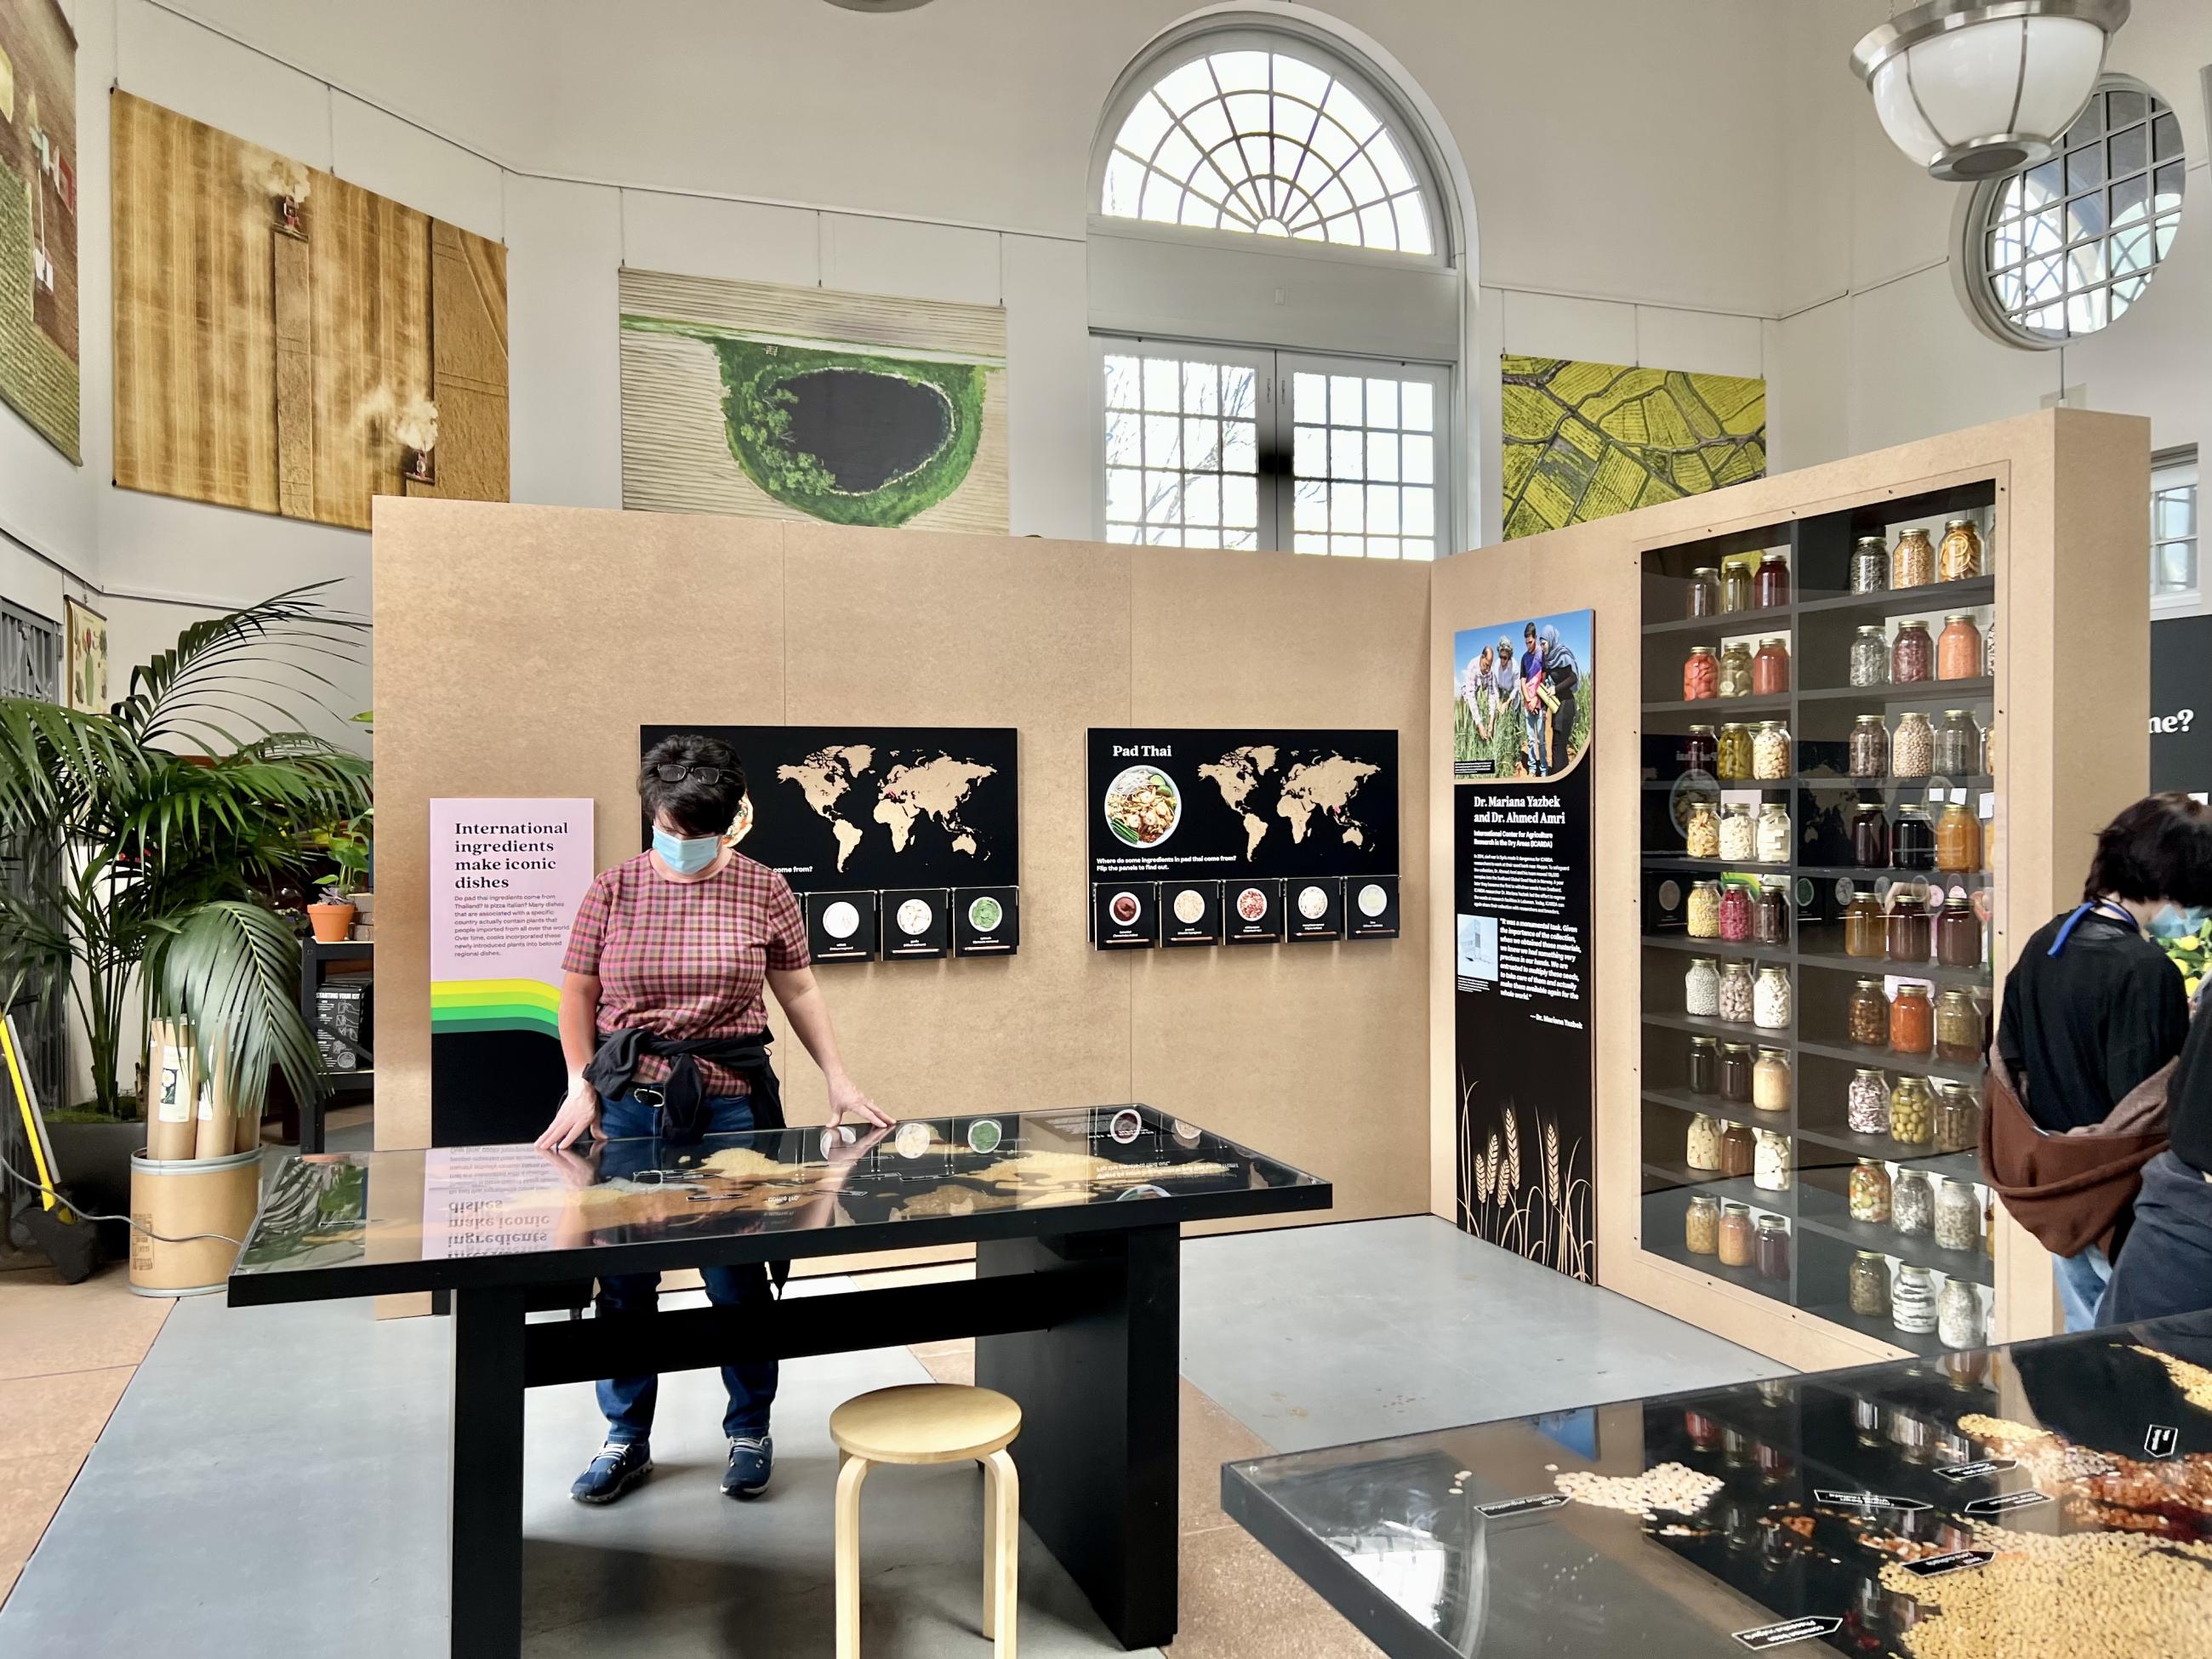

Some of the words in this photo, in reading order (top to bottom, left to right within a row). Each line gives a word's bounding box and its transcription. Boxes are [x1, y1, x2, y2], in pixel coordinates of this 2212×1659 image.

[1113, 745, 1138, 757] Pad
[1141, 745, 1172, 756] Thai
[1474, 796, 1487, 807] Dr.
[1489, 796, 1526, 807] Mariana
[1527, 795, 1560, 807] Yazbek
[1474, 811, 1490, 822] and
[1491, 812, 1505, 823] Dr.
[1506, 812, 1539, 823] Ahmed
[1540, 812, 1565, 824] Amri
[455, 823, 568, 834] International
[455, 840, 554, 855] ingredients
[455, 859, 501, 870] make
[506, 858, 556, 869] iconic
[455, 877, 509, 888] dishes
[1508, 927, 1535, 937] importance
[1550, 933, 1576, 943] collection,
[1521, 939, 1542, 947] obtained
[1557, 944, 1581, 953] materials,
[1534, 958, 1550, 966] hands.
[1538, 951, 1564, 961] something
[1529, 968, 1548, 977] multiply
[1563, 973, 1579, 982] seeds,
[1526, 985, 1547, 994] available
[1557, 982, 1577, 991] actually
[1543, 1015, 1564, 1025] Mariana
[1564, 1019, 1583, 1029] Yazbek
